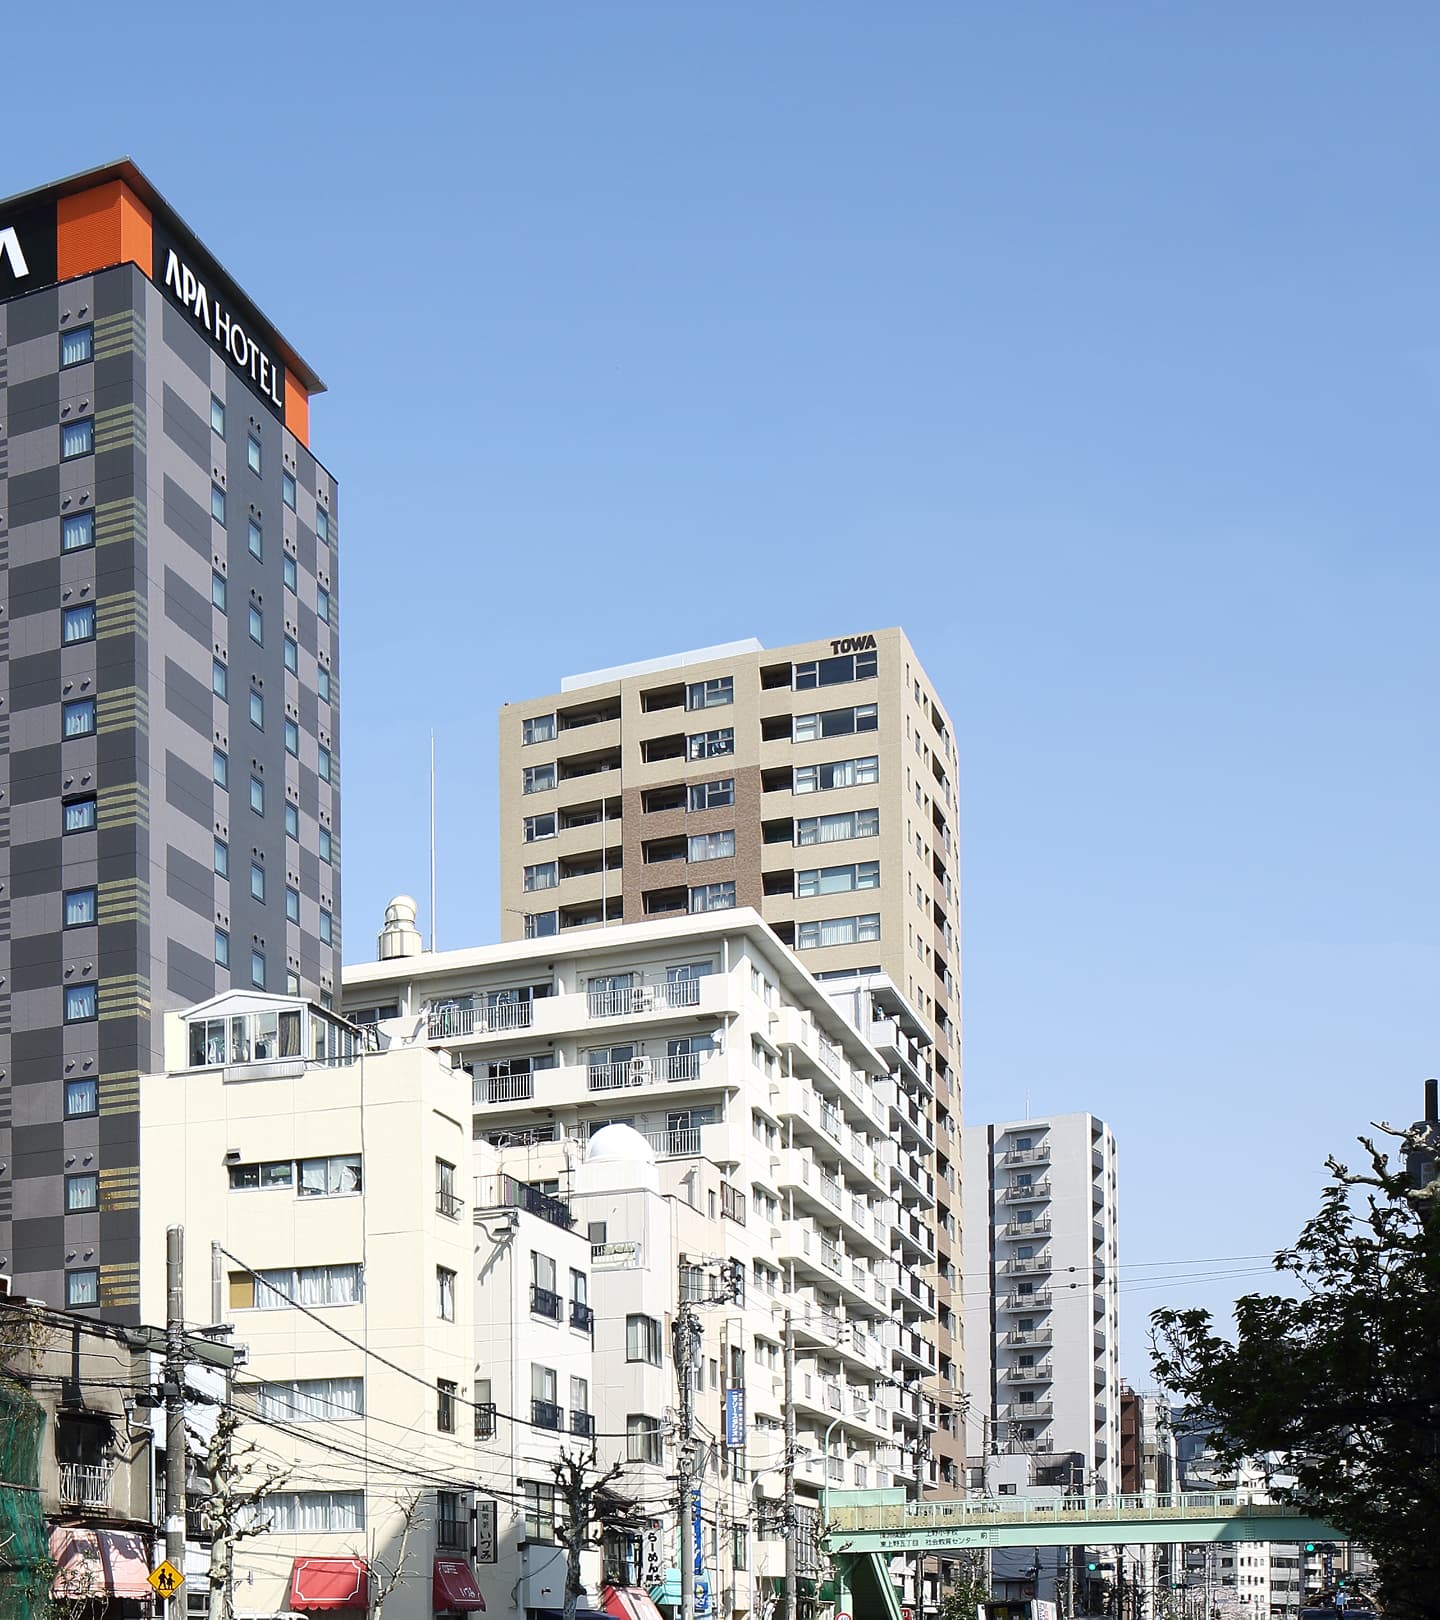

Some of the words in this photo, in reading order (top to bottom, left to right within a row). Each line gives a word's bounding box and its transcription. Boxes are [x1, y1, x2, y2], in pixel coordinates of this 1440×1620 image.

[165, 249, 211, 330] APA
[215, 301, 282, 408] HOTEL
[830, 634, 877, 655] TOWA
[647, 1532, 659, 1574] らーめん
